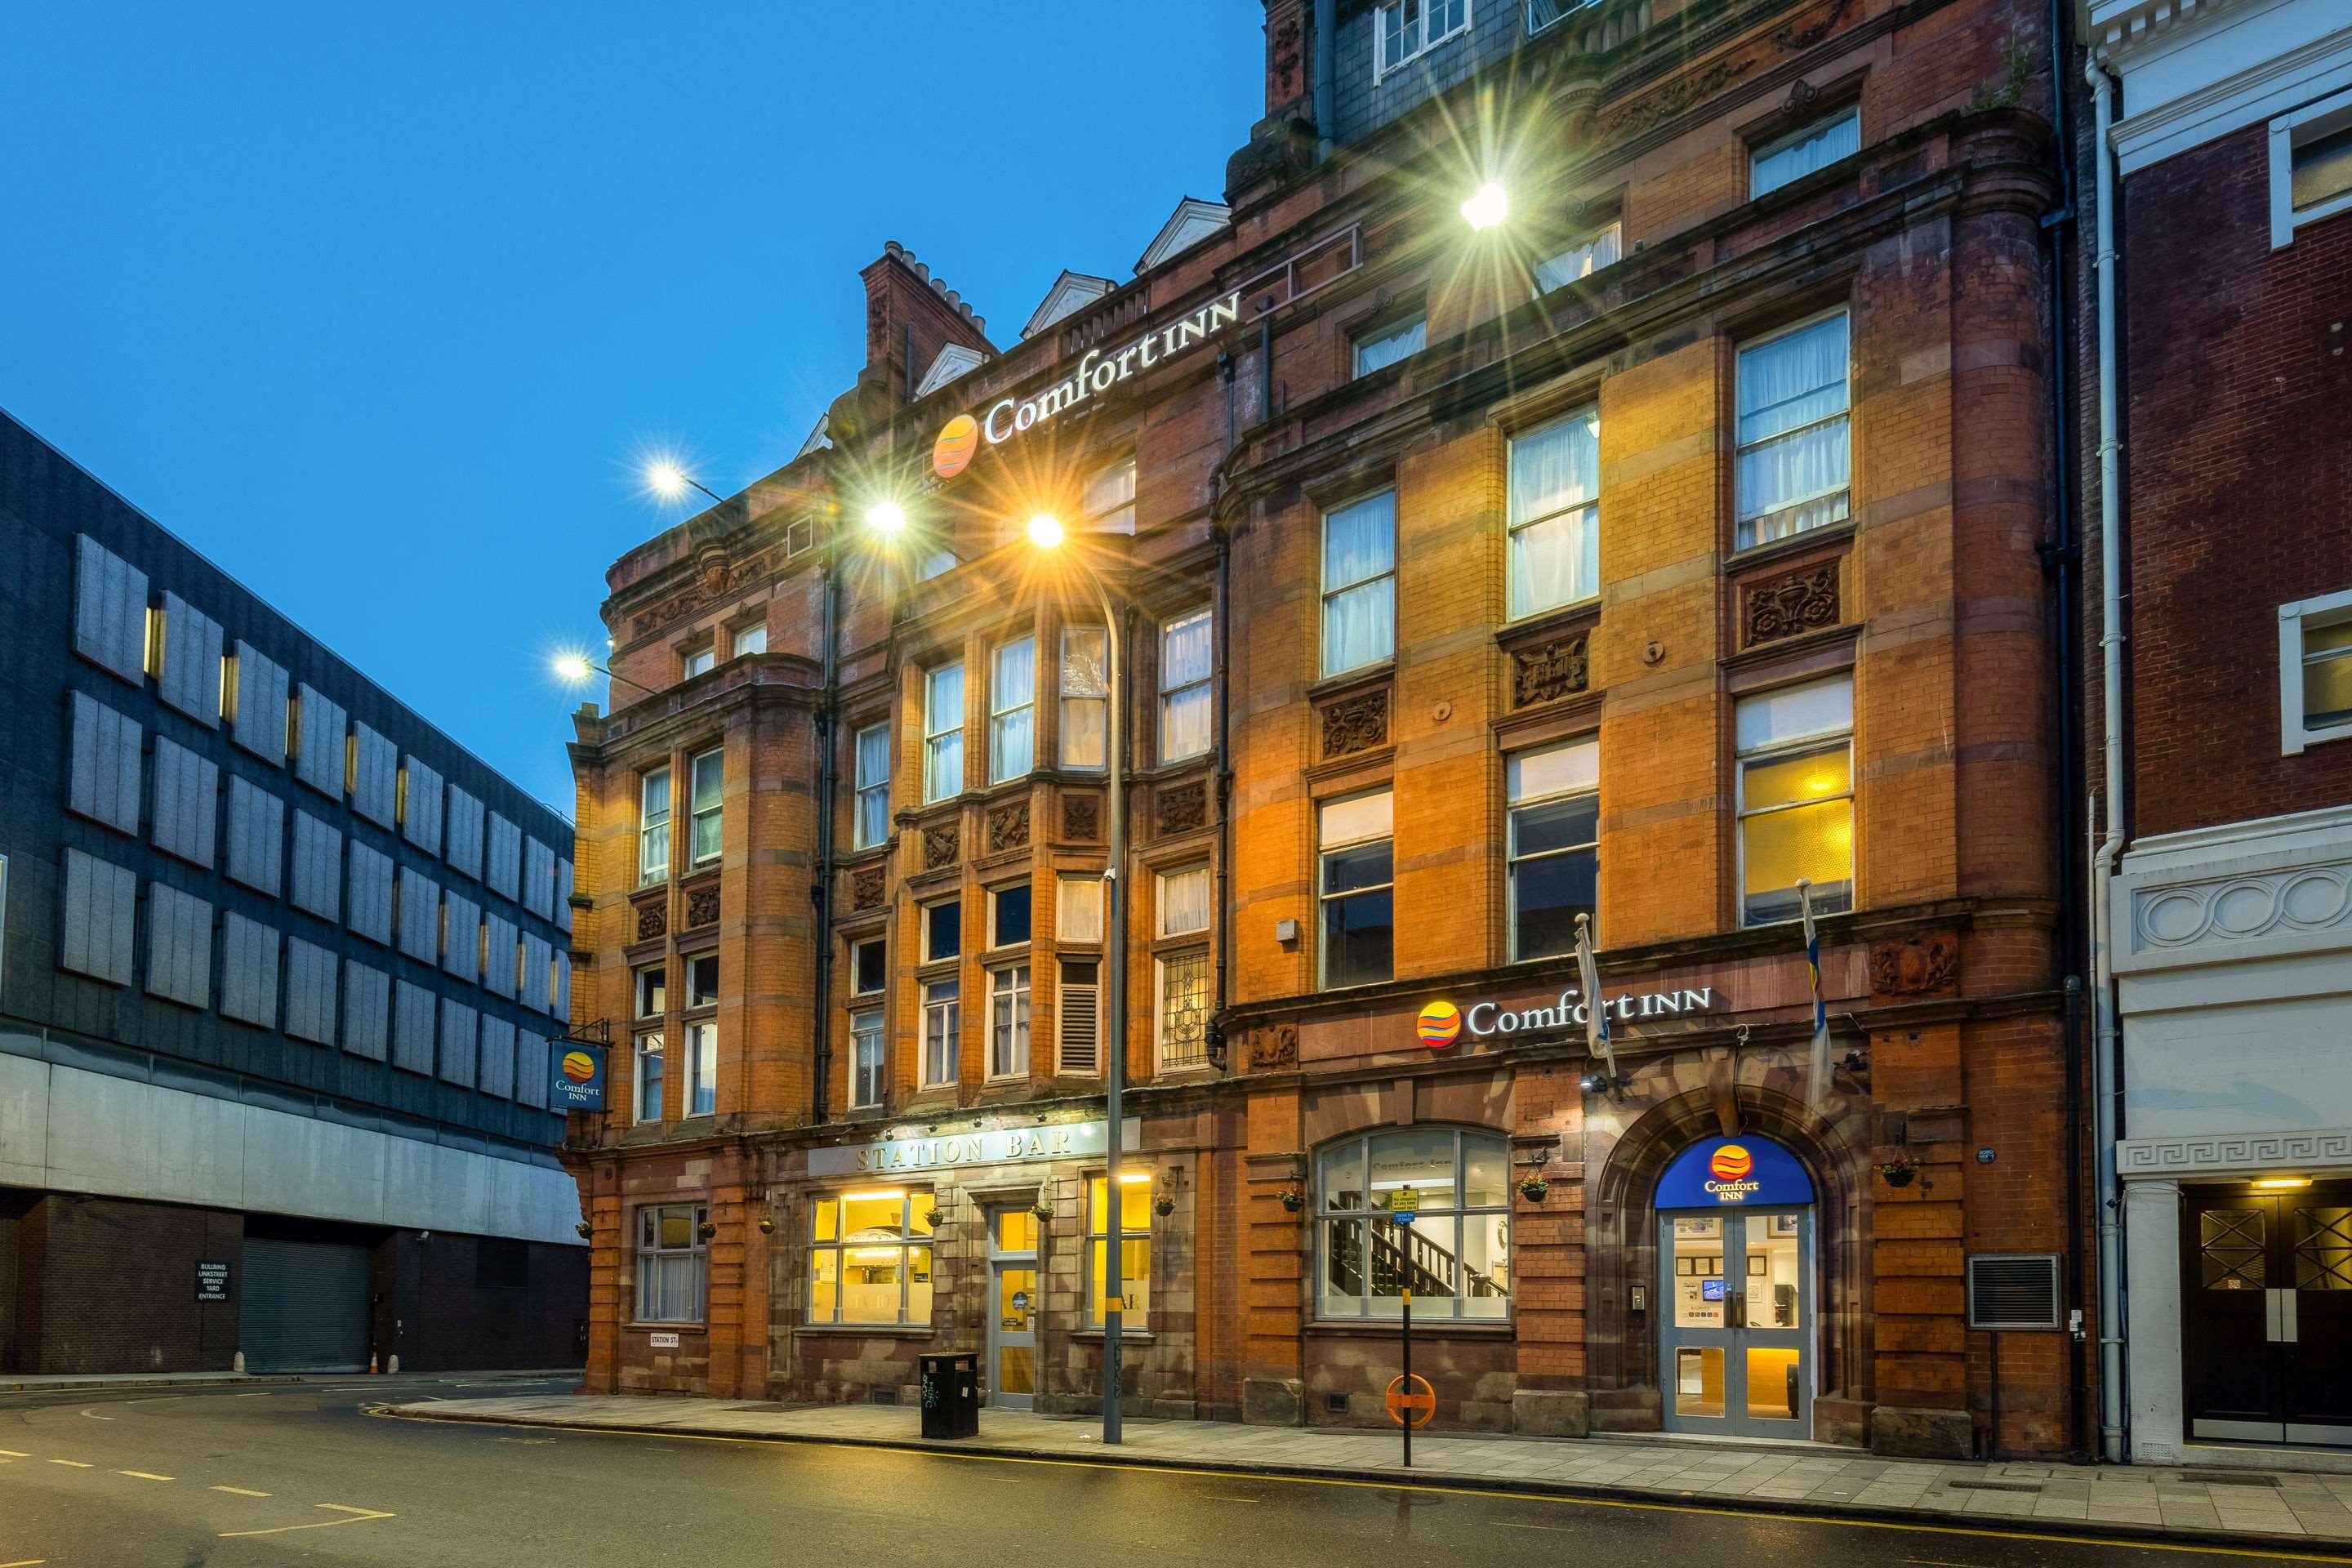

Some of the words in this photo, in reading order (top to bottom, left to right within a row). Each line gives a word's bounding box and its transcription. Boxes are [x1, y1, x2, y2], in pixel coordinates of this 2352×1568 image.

[984, 333, 1158, 444] Comfort
[1163, 291, 1241, 358] INN
[1468, 989, 1635, 1036] Comfort
[1639, 987, 1712, 1017] INN
[555, 1080, 601, 1096] Comfort
[568, 1092, 587, 1102] INN
[858, 1138, 984, 1171] STATION
[1005, 1130, 1071, 1158] BAR
[1704, 1178, 1759, 1192] Comfort
[1720, 1192, 1743, 1200] INN
